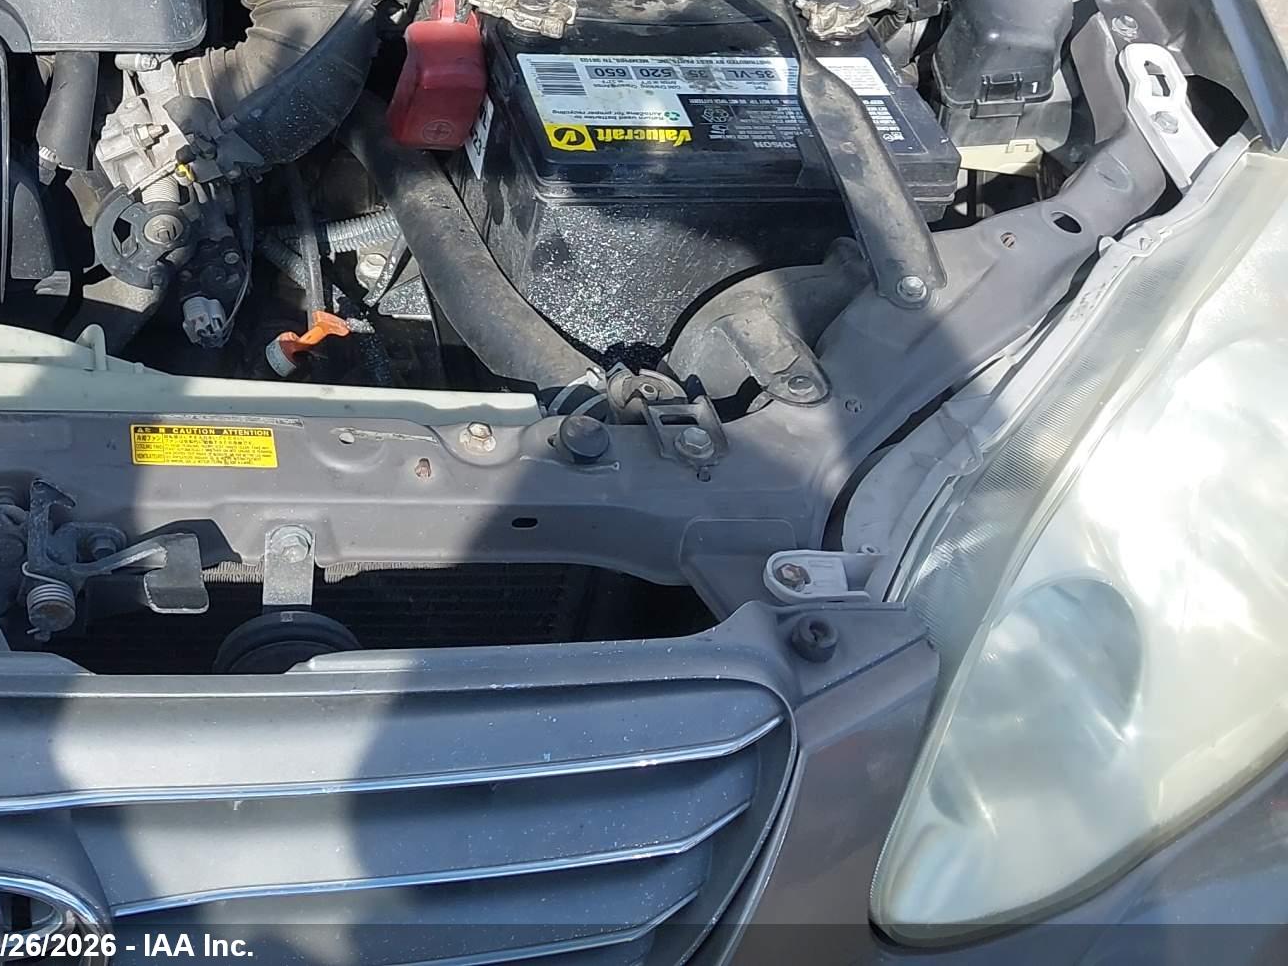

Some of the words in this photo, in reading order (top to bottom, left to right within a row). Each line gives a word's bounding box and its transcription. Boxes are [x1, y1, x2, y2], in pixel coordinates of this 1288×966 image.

[594, 68, 626, 78] 650
[639, 68, 671, 78] 520
[689, 70, 708, 79] 35
[728, 69, 775, 79] 35-VL
[1031, 81, 1039, 94] 1
[594, 129, 691, 147] Valucraft
